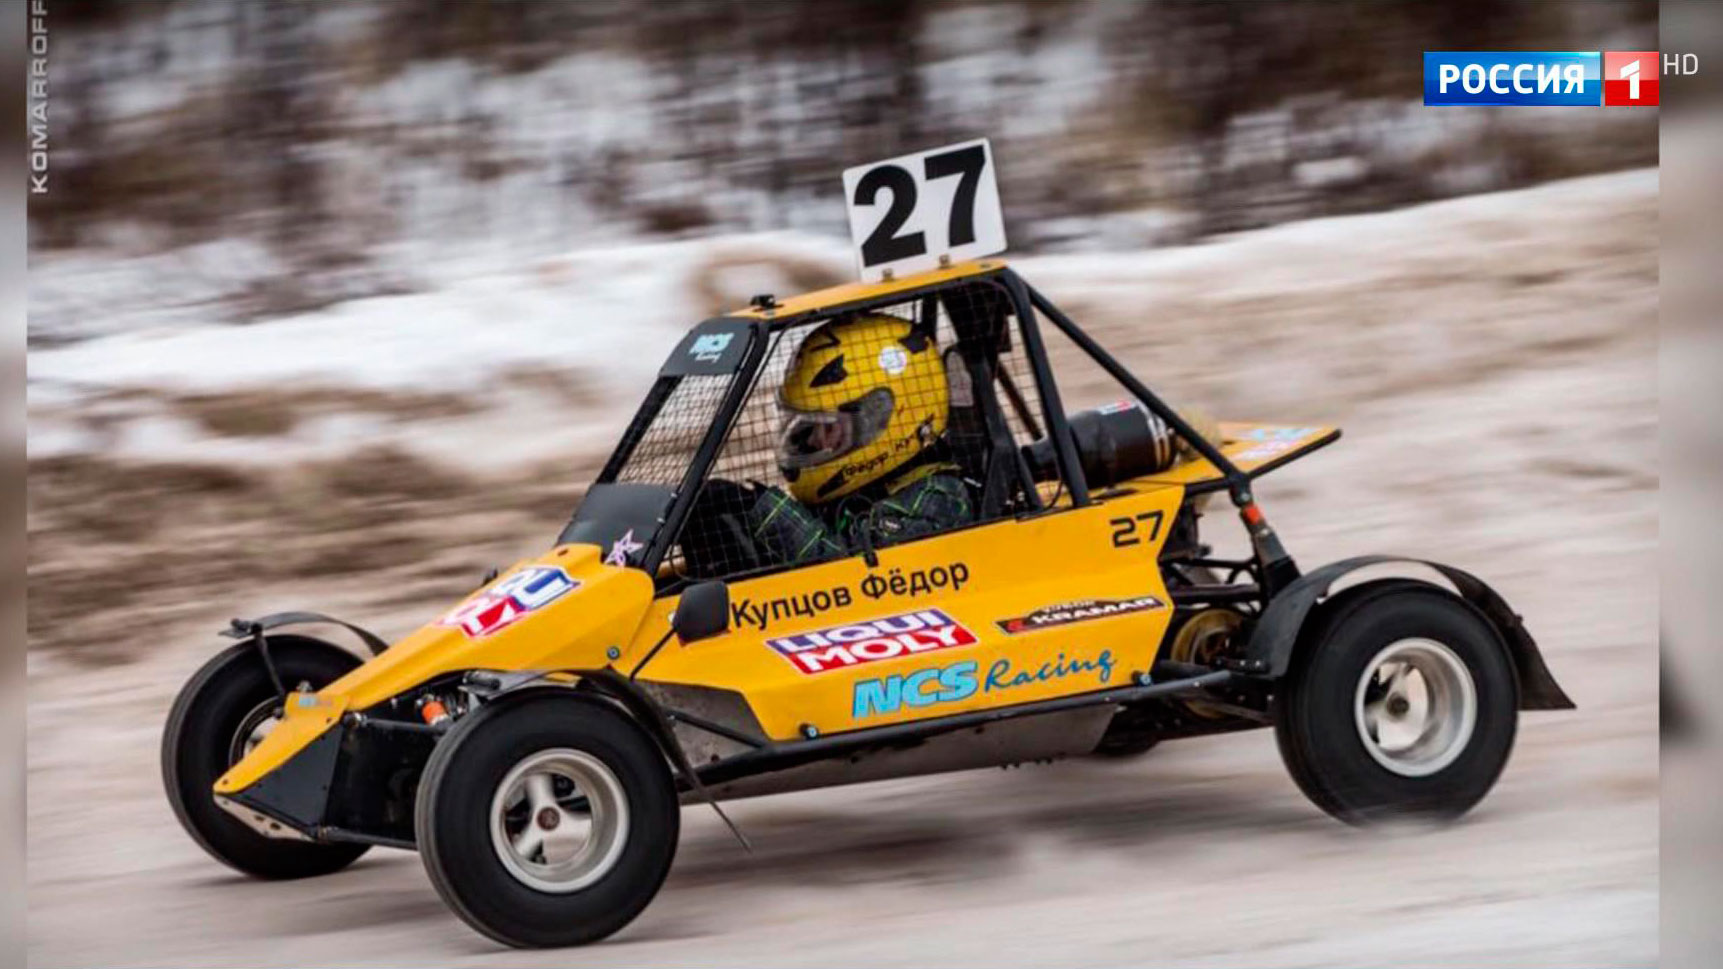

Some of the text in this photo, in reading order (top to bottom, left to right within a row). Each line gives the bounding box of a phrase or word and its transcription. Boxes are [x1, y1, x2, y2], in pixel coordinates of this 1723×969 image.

[853, 144, 987, 269] 27
[1109, 509, 1164, 548] 27
[731, 561, 969, 631] Купцов Фёдор
[774, 608, 949, 653] LIQUI
[797, 624, 962, 672] MOLY
[852, 649, 1118, 720] NCS Racing
